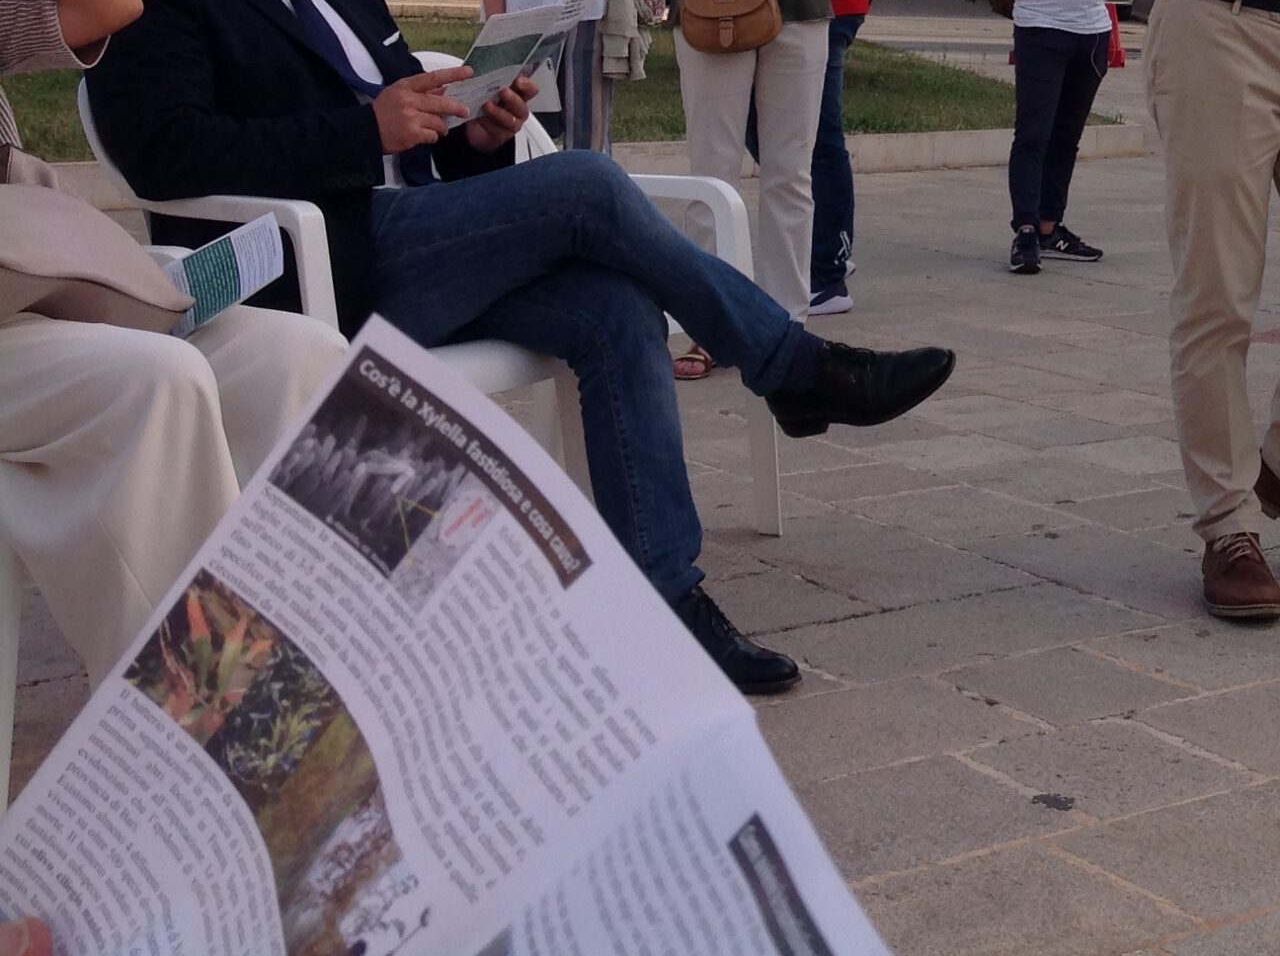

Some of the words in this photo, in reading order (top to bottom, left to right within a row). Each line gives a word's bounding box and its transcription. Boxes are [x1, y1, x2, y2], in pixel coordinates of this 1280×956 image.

[359, 359, 401, 396] Cos'è
[400, 387, 418, 409] la
[417, 401, 467, 447] Xylella
[466, 440, 522, 502] fastidiosa
[520, 499, 531, 512] e
[527, 508, 553, 539] cosa
[208, 559, 259, 601] circostanti
[258, 598, 273, 613] da
[295, 556, 315, 576] 3-5
[219, 545, 264, 582] specifico
[263, 579, 289, 602] della
[288, 600, 324, 635] malattia
[106, 704, 136, 731] prima
[130, 696, 165, 732] batterio
[98, 718, 140, 758] numerosi
[56, 773, 96, 813] Esistono
[64, 761, 109, 802] provincia
[108, 799, 121, 812] di
[77, 747, 128, 795] evidenziato
[130, 796, 146, 814] che
[13, 832, 32, 850] cui
[25, 817, 67, 860] fastidiosa
[47, 789, 76, 818] vivere
[75, 816, 88, 830] su
[86, 828, 108, 851] oltre
